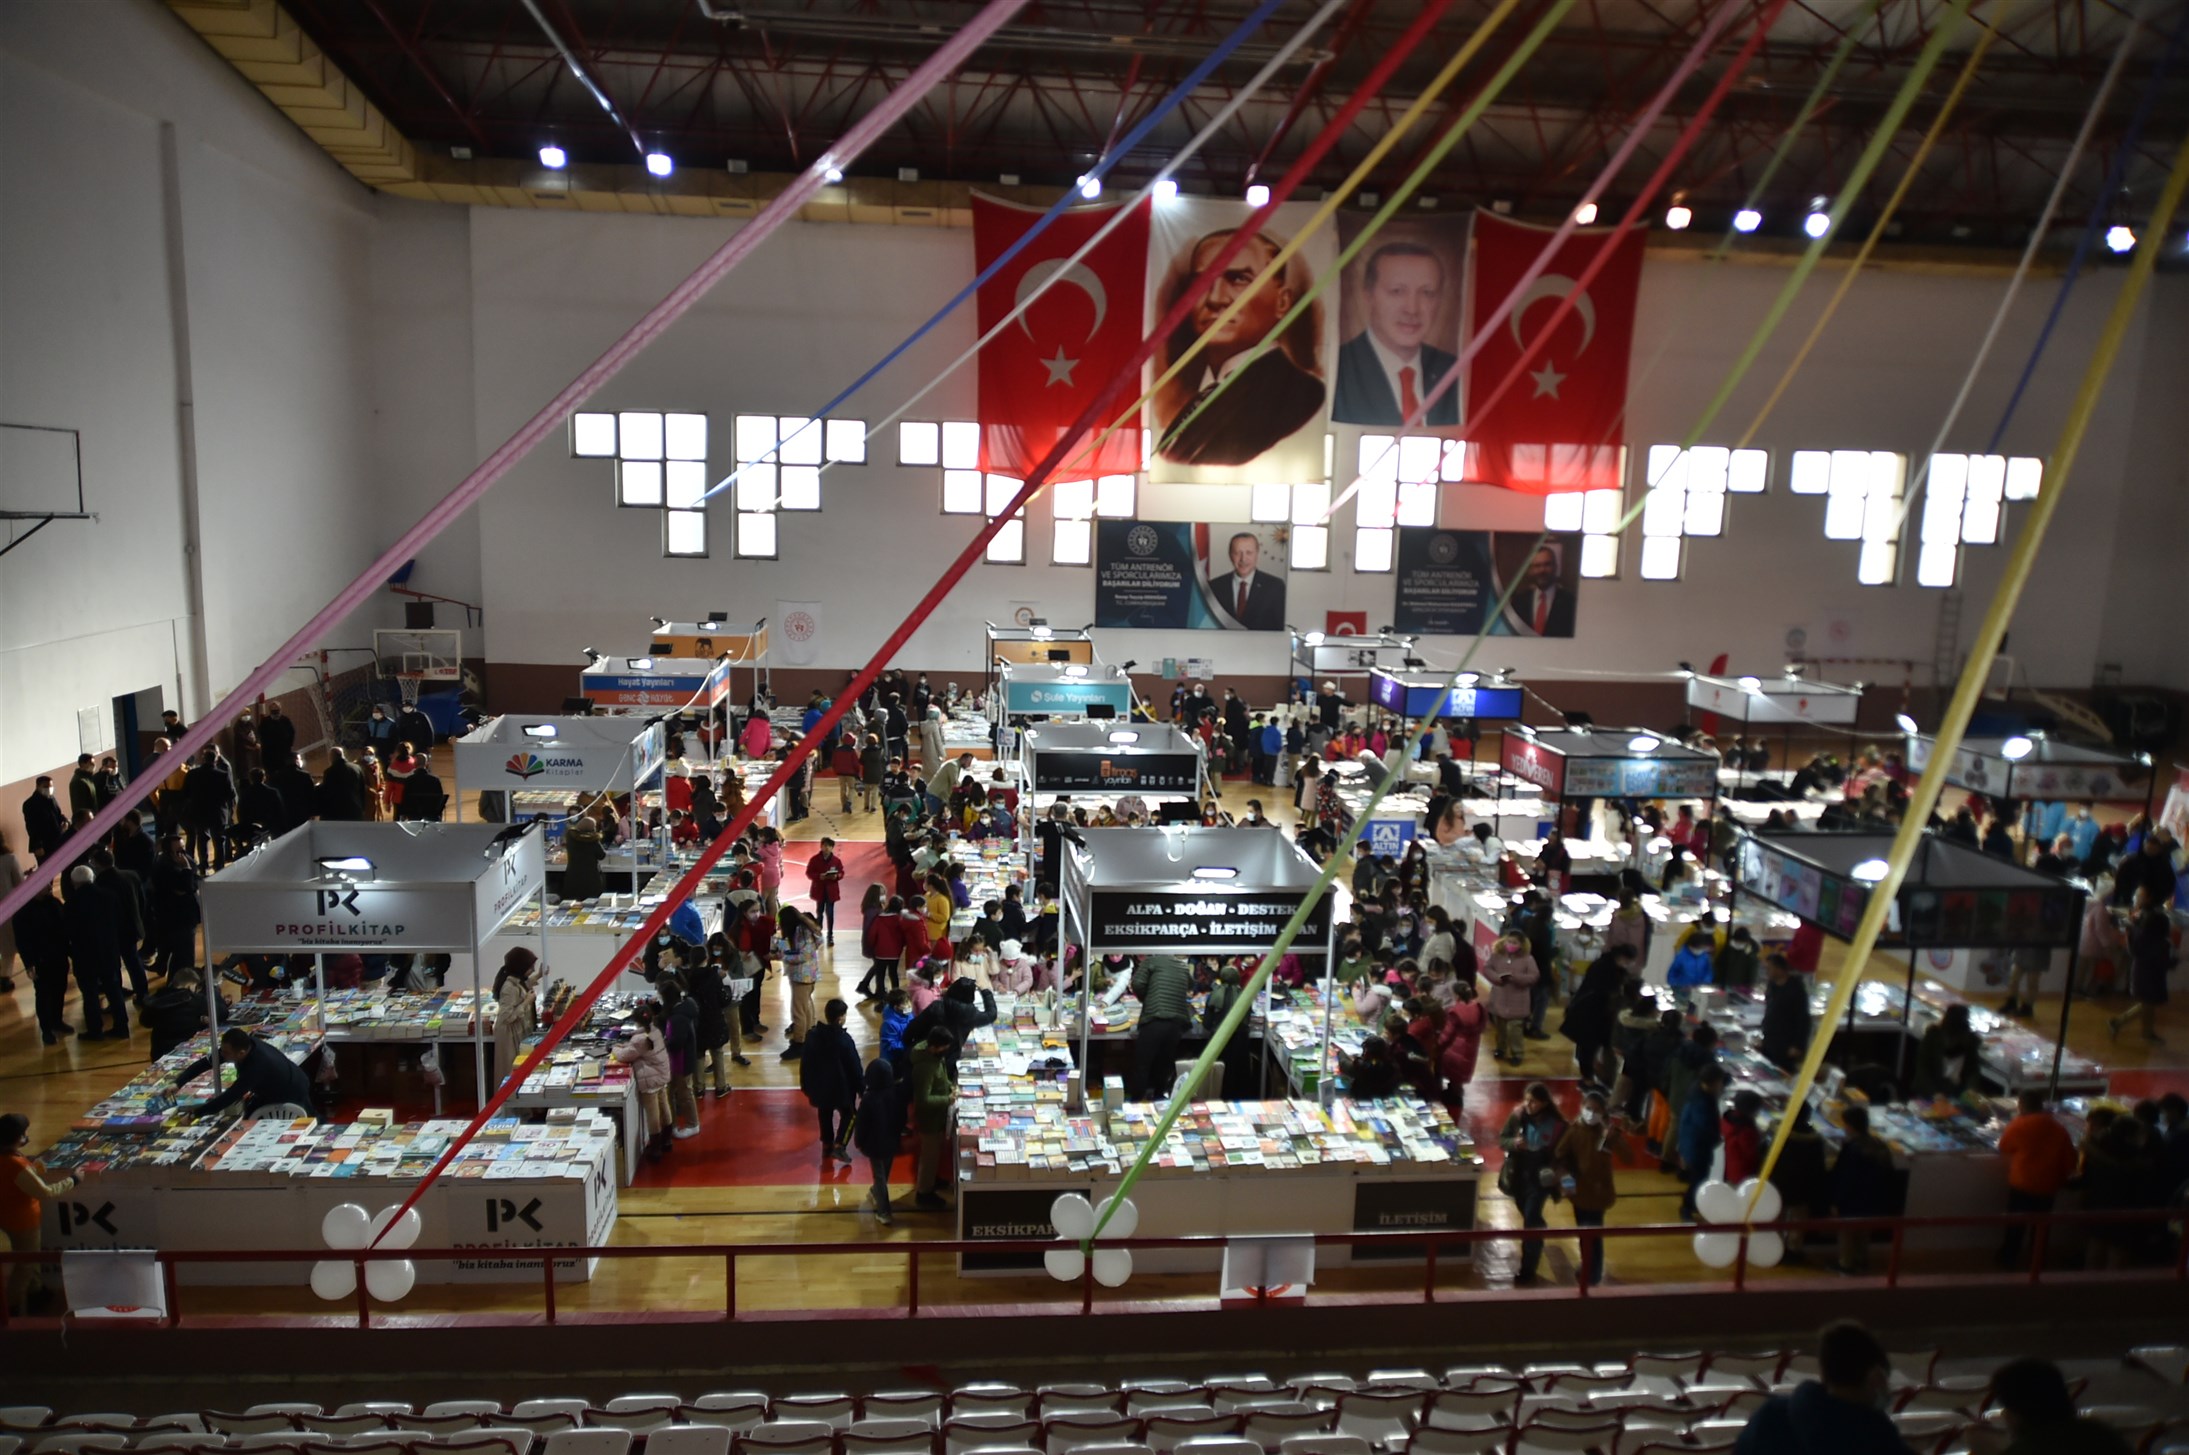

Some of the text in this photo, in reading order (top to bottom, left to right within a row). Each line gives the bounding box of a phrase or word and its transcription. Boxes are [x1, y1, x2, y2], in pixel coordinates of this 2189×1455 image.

[1110, 561, 1174, 572] TÜM ANTRENÖR
[1101, 571, 1111, 579] VE
[618, 677, 641, 689] Hayat
[545, 758, 584, 768] KARMA
[1126, 901, 1299, 916] ALFA DOĞAN DESTEK
[275, 920, 406, 936] PROFİLKİTAP
[1104, 922, 1199, 938] EKSİKPARÇA
[1209, 921, 1277, 938] İLETİŞİM
[1378, 1211, 1448, 1227] İLETİŞİM
[972, 1222, 1057, 1237] EKSİKPAR
[477, 1258, 514, 1269] kitaba
[515, 1258, 582, 1269] inanıoruz"
